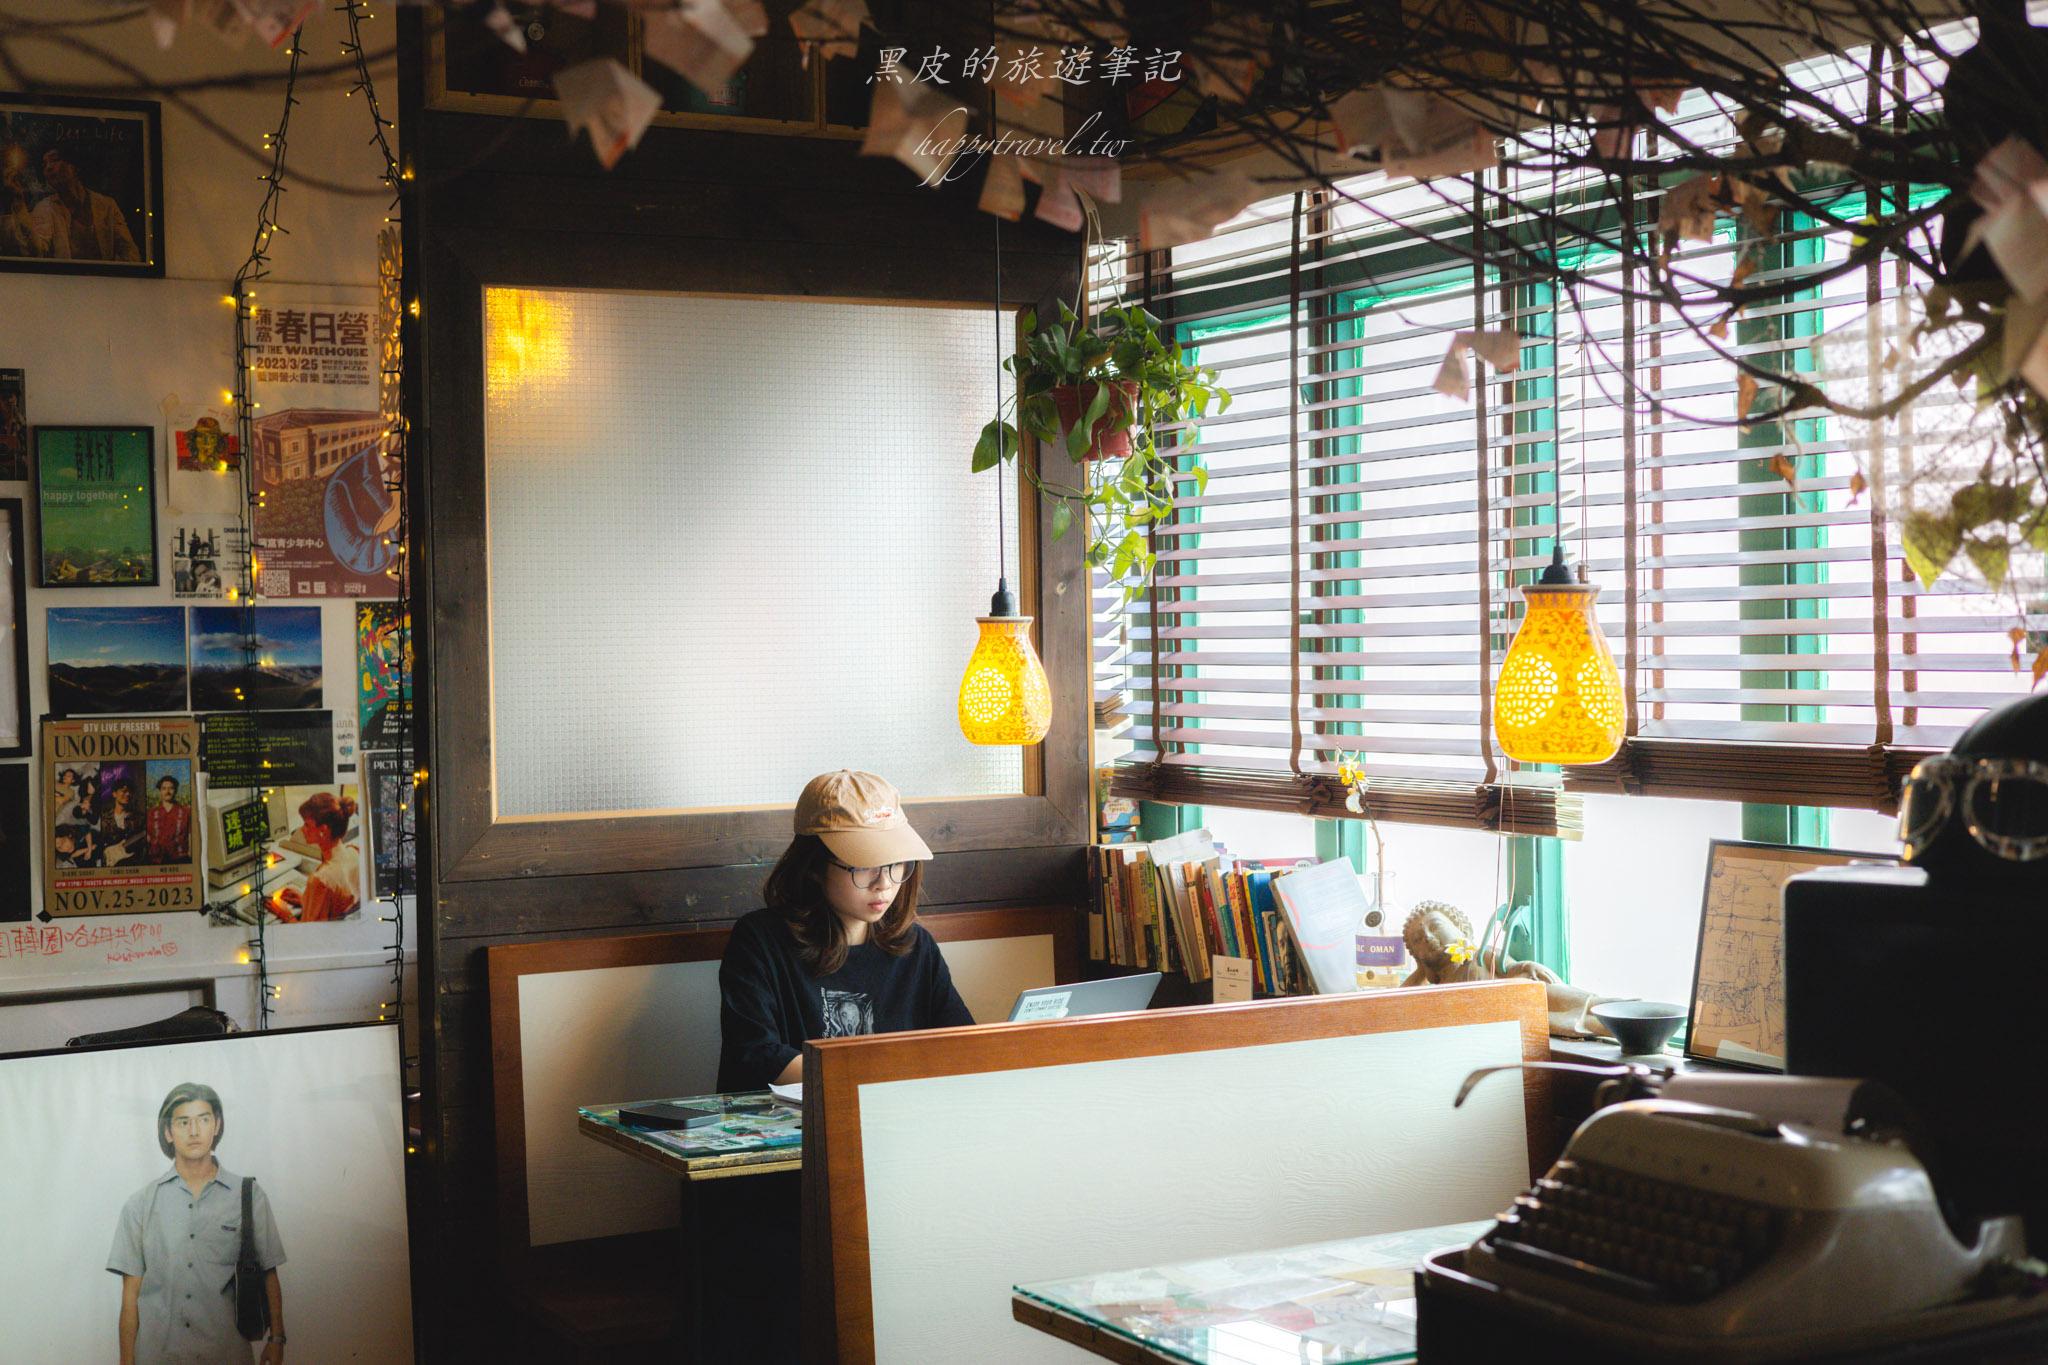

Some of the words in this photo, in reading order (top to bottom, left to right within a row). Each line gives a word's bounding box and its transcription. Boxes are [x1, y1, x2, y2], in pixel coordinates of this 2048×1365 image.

[275, 309, 369, 346] 春日營
[268, 345, 283, 354] THE
[285, 346, 369, 357] WAREHOUSE
[256, 357, 318, 370] 2023/3/25
[43, 490, 74, 504] happy
[76, 490, 118, 502] together
[101, 723, 119, 732] LIVE
[120, 722, 160, 732] PRESENTS
[54, 734, 96, 758] UNO
[100, 733, 140, 757] DOS
[142, 732, 192, 756] TRES
